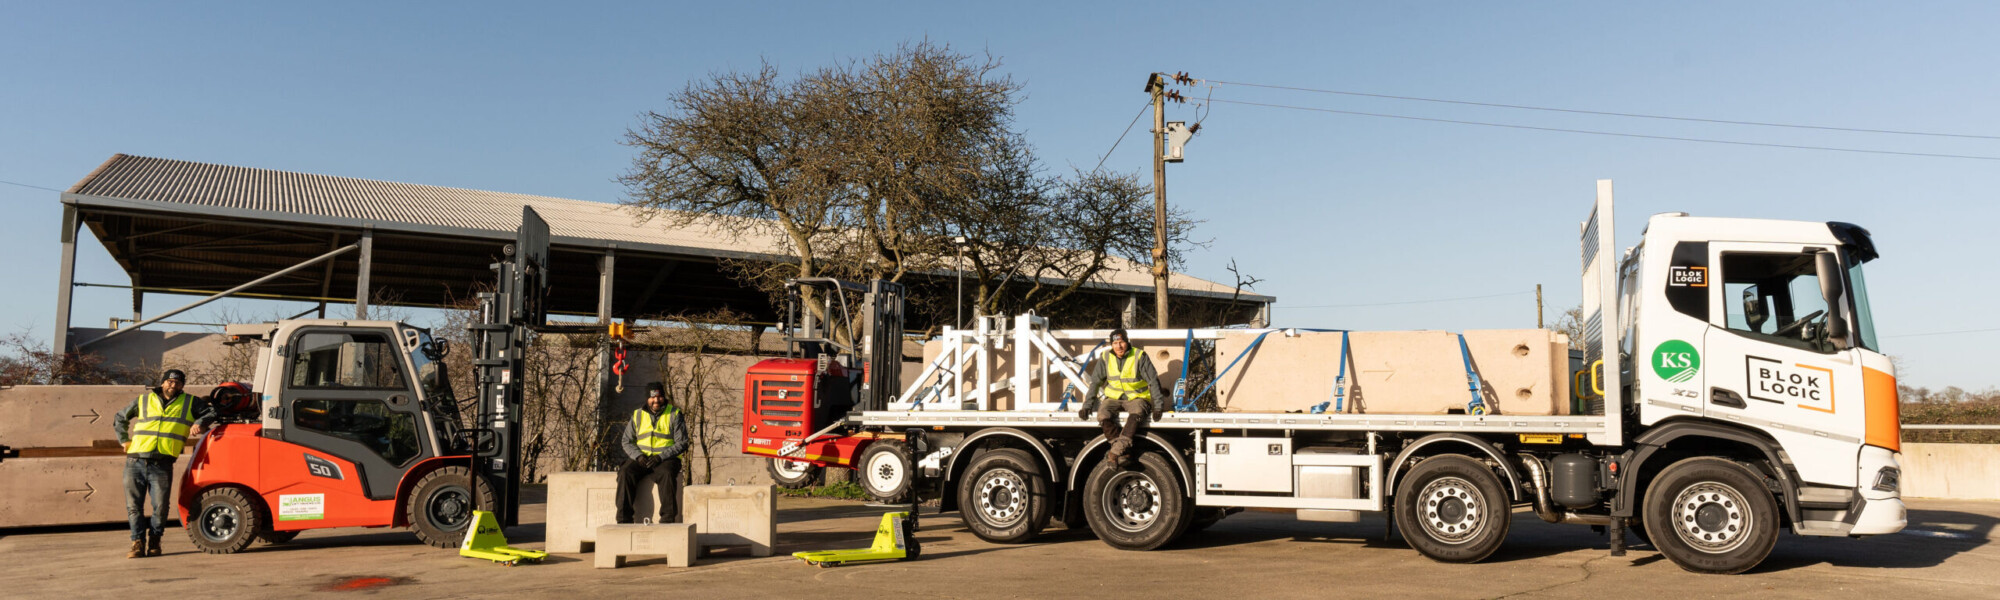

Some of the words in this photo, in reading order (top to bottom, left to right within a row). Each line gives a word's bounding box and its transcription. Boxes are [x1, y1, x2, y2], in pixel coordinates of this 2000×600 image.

[1660, 352, 1691, 368] KS
[1760, 367, 1819, 388] BLOK
[1671, 388, 1699, 398] XD
[1760, 380, 1820, 401] LOGIC
[310, 463, 331, 477] 50
